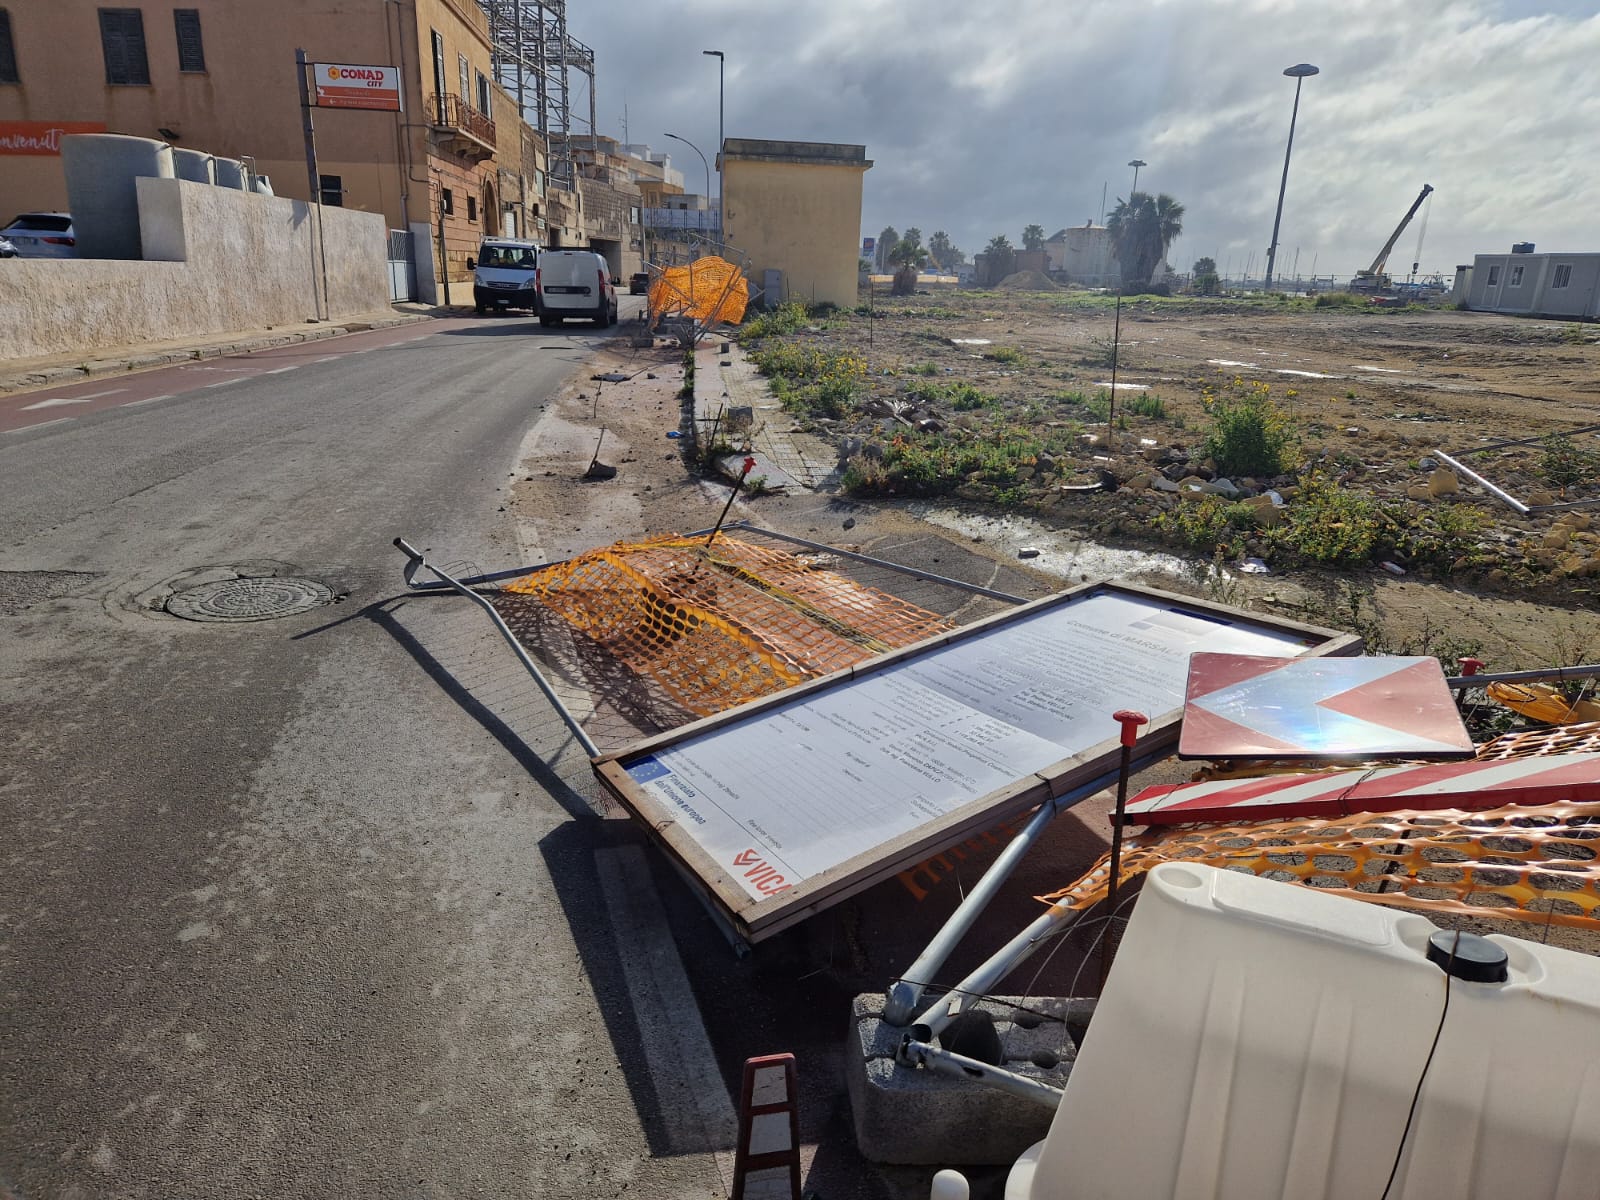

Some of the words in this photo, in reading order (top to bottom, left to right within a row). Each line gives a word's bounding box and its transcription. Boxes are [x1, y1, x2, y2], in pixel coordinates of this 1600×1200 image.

[341, 69, 384, 81] CONAD
[367, 80, 383, 88] CITY
[1047, 701, 1066, 710] VELLA
[1055, 697, 1074, 706] VELLA
[669, 774, 696, 798] Finanziato
[680, 804, 707, 825] europea
[744, 861, 792, 895] VICA
